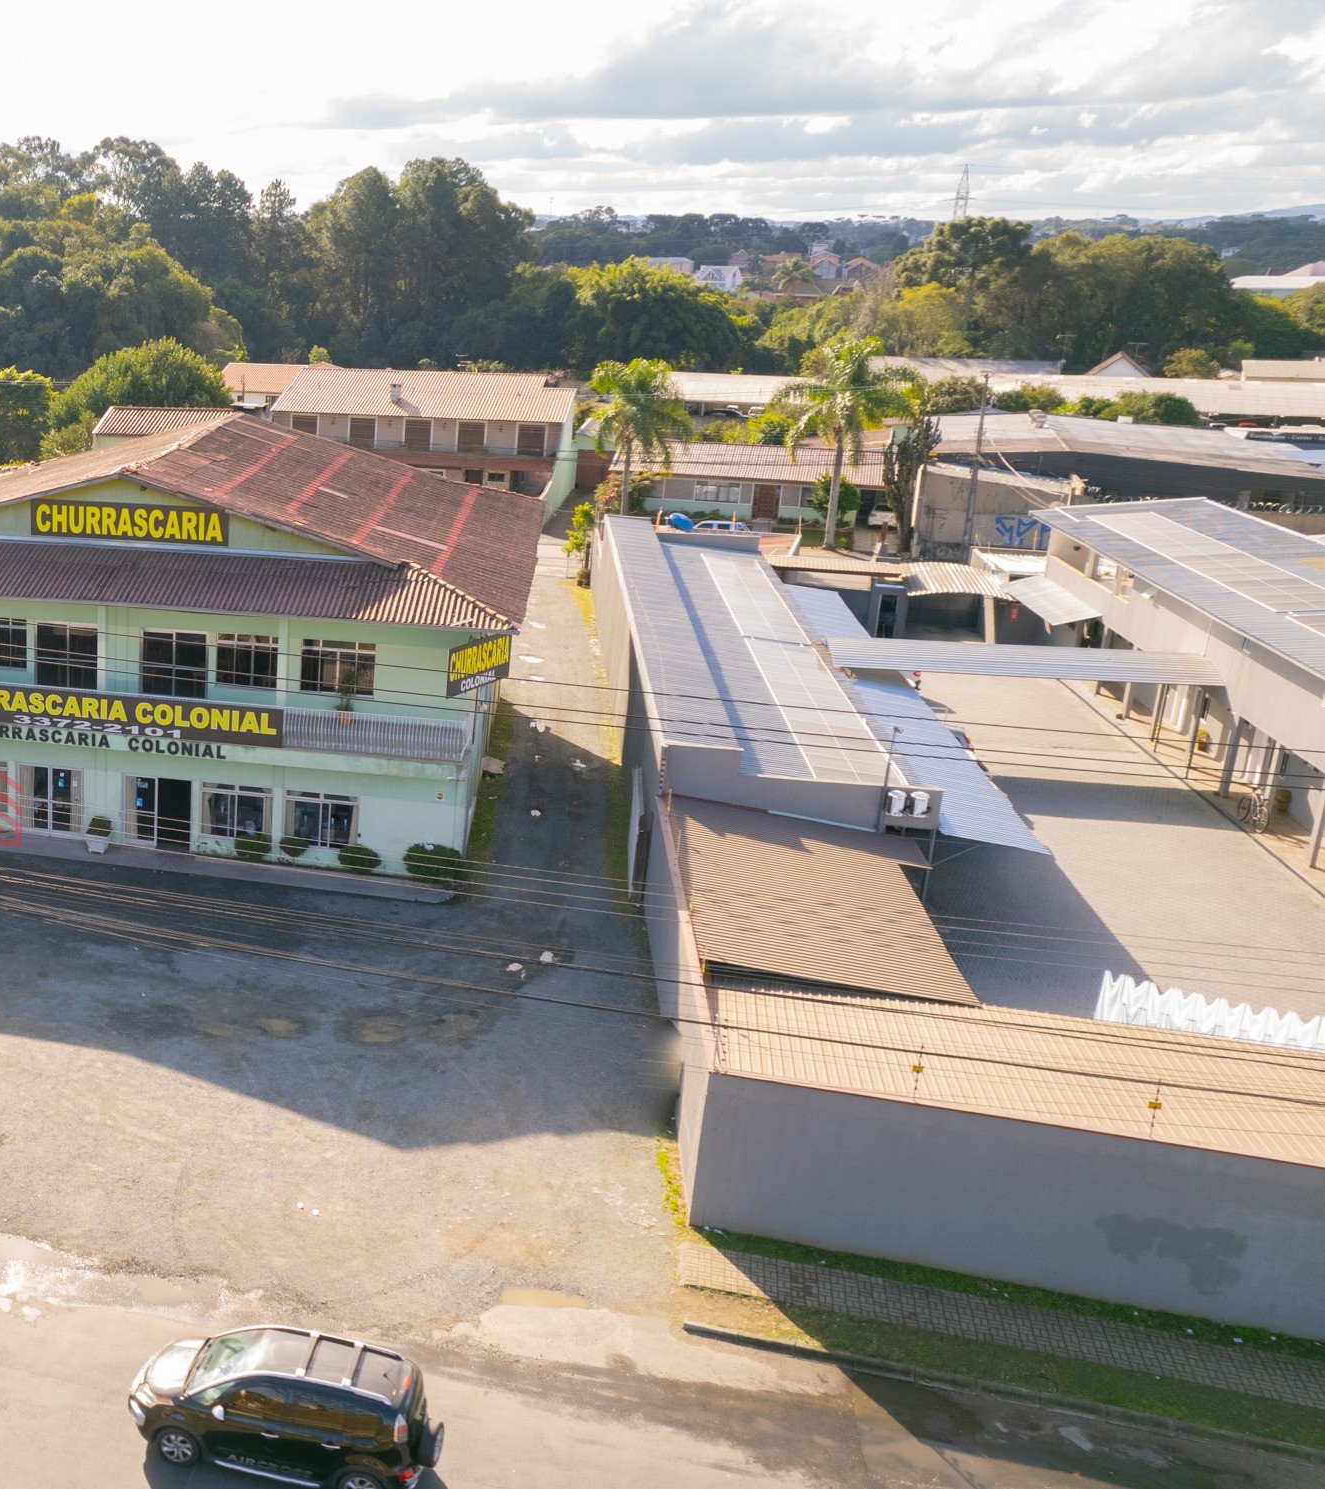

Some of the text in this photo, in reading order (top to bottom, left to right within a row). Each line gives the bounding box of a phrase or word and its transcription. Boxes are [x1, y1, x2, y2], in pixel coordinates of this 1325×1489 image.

[36, 504, 223, 542] CHURRASCARIA
[449, 635, 510, 682] CHURRASCARIA
[460, 669, 497, 691] COLONIAL
[13, 714, 181, 739] 3372-2101
[135, 702, 277, 736] COLONIAL
[128, 737, 227, 760] COLONIAL
[226, 1454, 313, 1479] AIRCROSS
